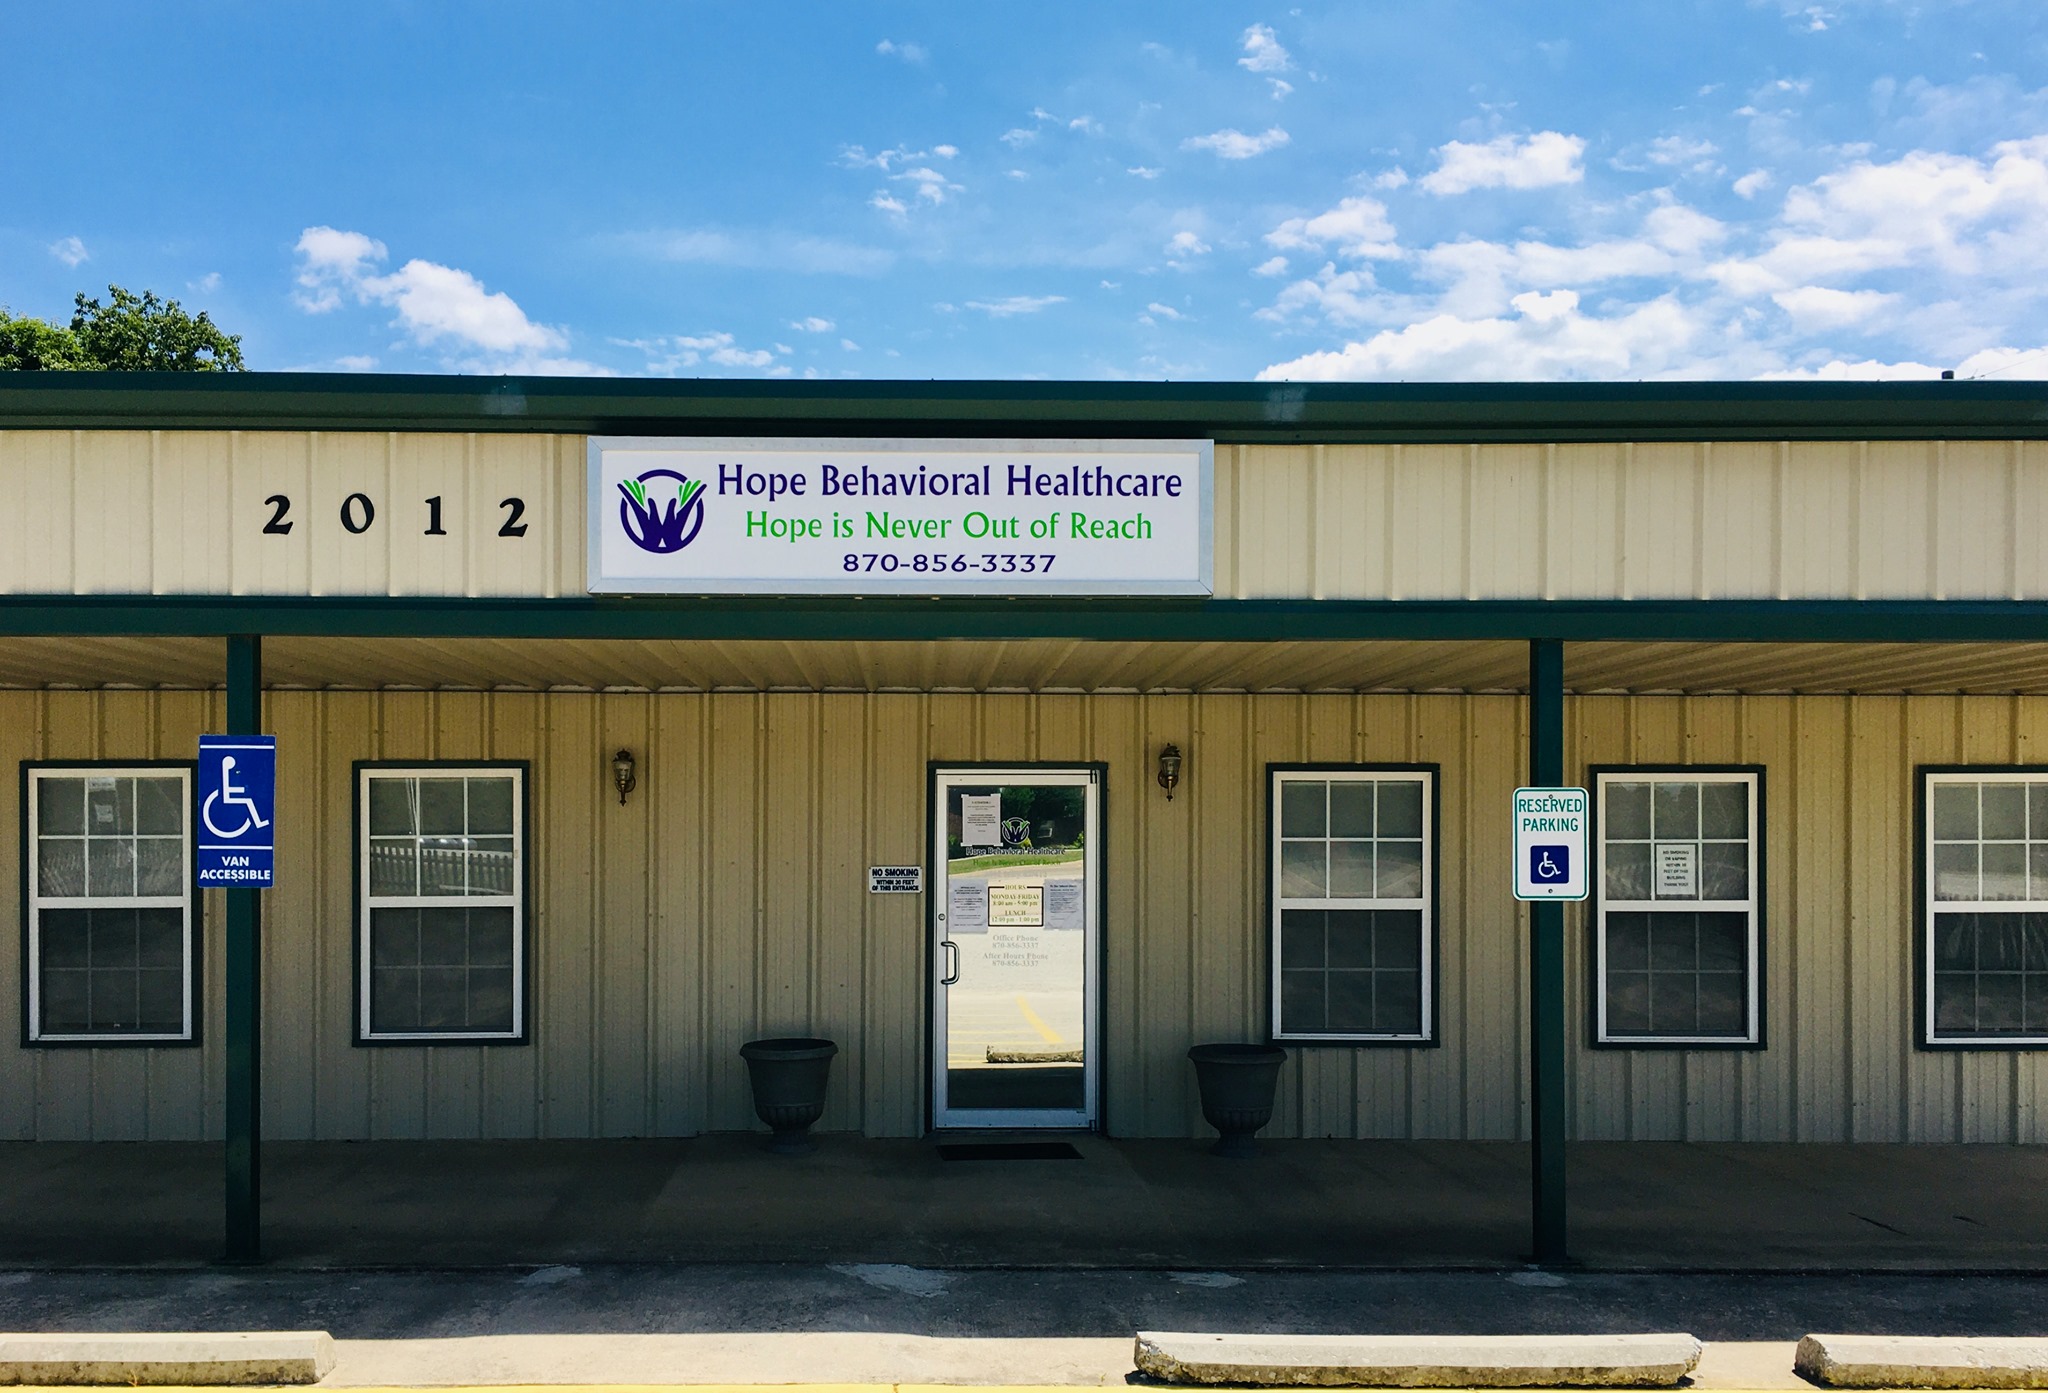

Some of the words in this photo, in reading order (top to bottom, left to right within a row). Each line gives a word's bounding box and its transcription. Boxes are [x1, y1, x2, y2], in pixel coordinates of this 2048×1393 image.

[718, 463, 807, 502] Hope
[821, 463, 990, 497] Behavioral
[1007, 464, 1182, 498] Healthcare
[746, 510, 822, 543] Hope
[833, 511, 854, 538] is
[865, 511, 952, 539] Never
[962, 511, 1020, 539] Out
[1029, 511, 1061, 539] of
[1071, 511, 1152, 539] Reach
[843, 553, 1056, 573] 870-856-3337
[1518, 798, 1583, 813] RESERVED
[1523, 818, 1579, 832] PARKING
[221, 856, 250, 867] VAN
[200, 869, 271, 880] ACCESSIBLE
[872, 868, 883, 877] NO
[885, 868, 919, 877] SMOKING
